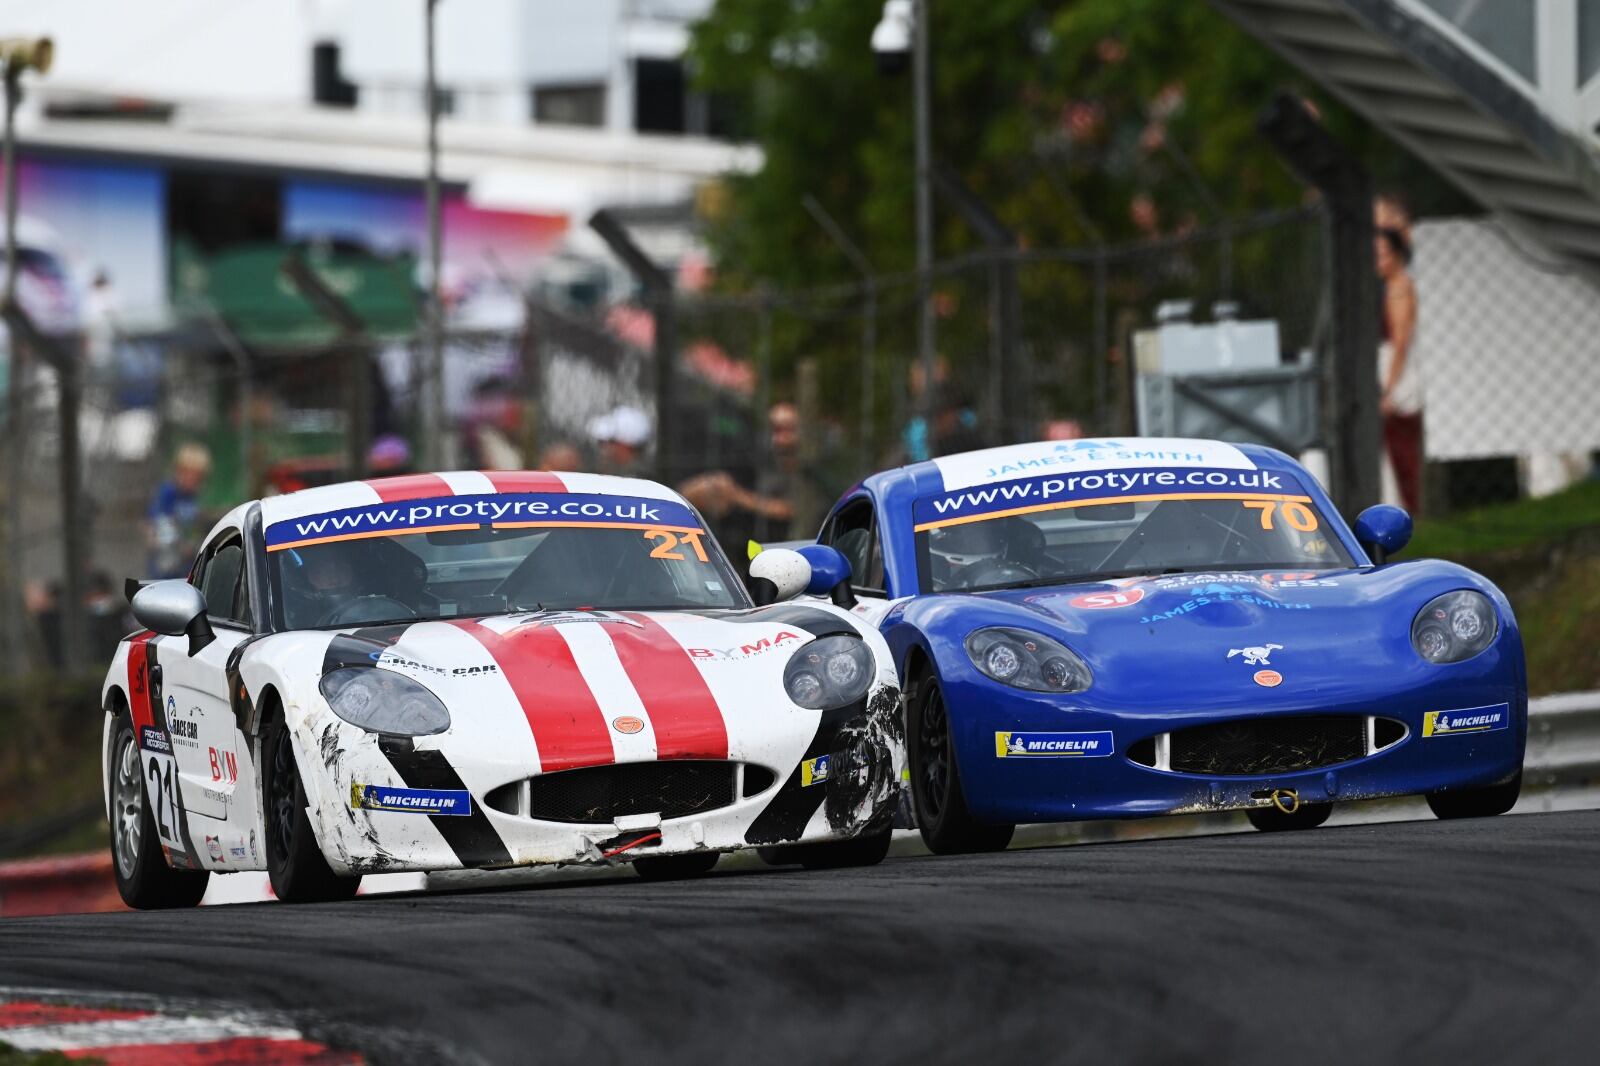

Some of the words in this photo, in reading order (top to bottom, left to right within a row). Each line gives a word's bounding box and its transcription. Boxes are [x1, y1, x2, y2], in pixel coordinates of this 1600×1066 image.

[986, 454, 1075, 478] JAMES
[1117, 451, 1204, 463] SMITH
[932, 470, 1282, 514] www.protyre.co.uk
[296, 500, 660, 536] www.protyre.co.uk
[1243, 501, 1318, 532] 70
[643, 530, 709, 562] 21
[1154, 573, 1339, 588] STAINESS
[1139, 597, 1211, 624] JAMES
[1241, 594, 1311, 609] SMITH
[687, 631, 800, 658] BYMA
[392, 658, 447, 674] RACE
[452, 664, 496, 675] CAR
[172, 718, 187, 737] RACE
[186, 721, 198, 740] CAR
[1451, 713, 1501, 728] MICHELIN
[146, 738, 170, 751] MOTORSPOR
[1028, 740, 1099, 750] MICHELIN
[149, 756, 179, 843] 21
[382, 795, 457, 808] MICHELIN
